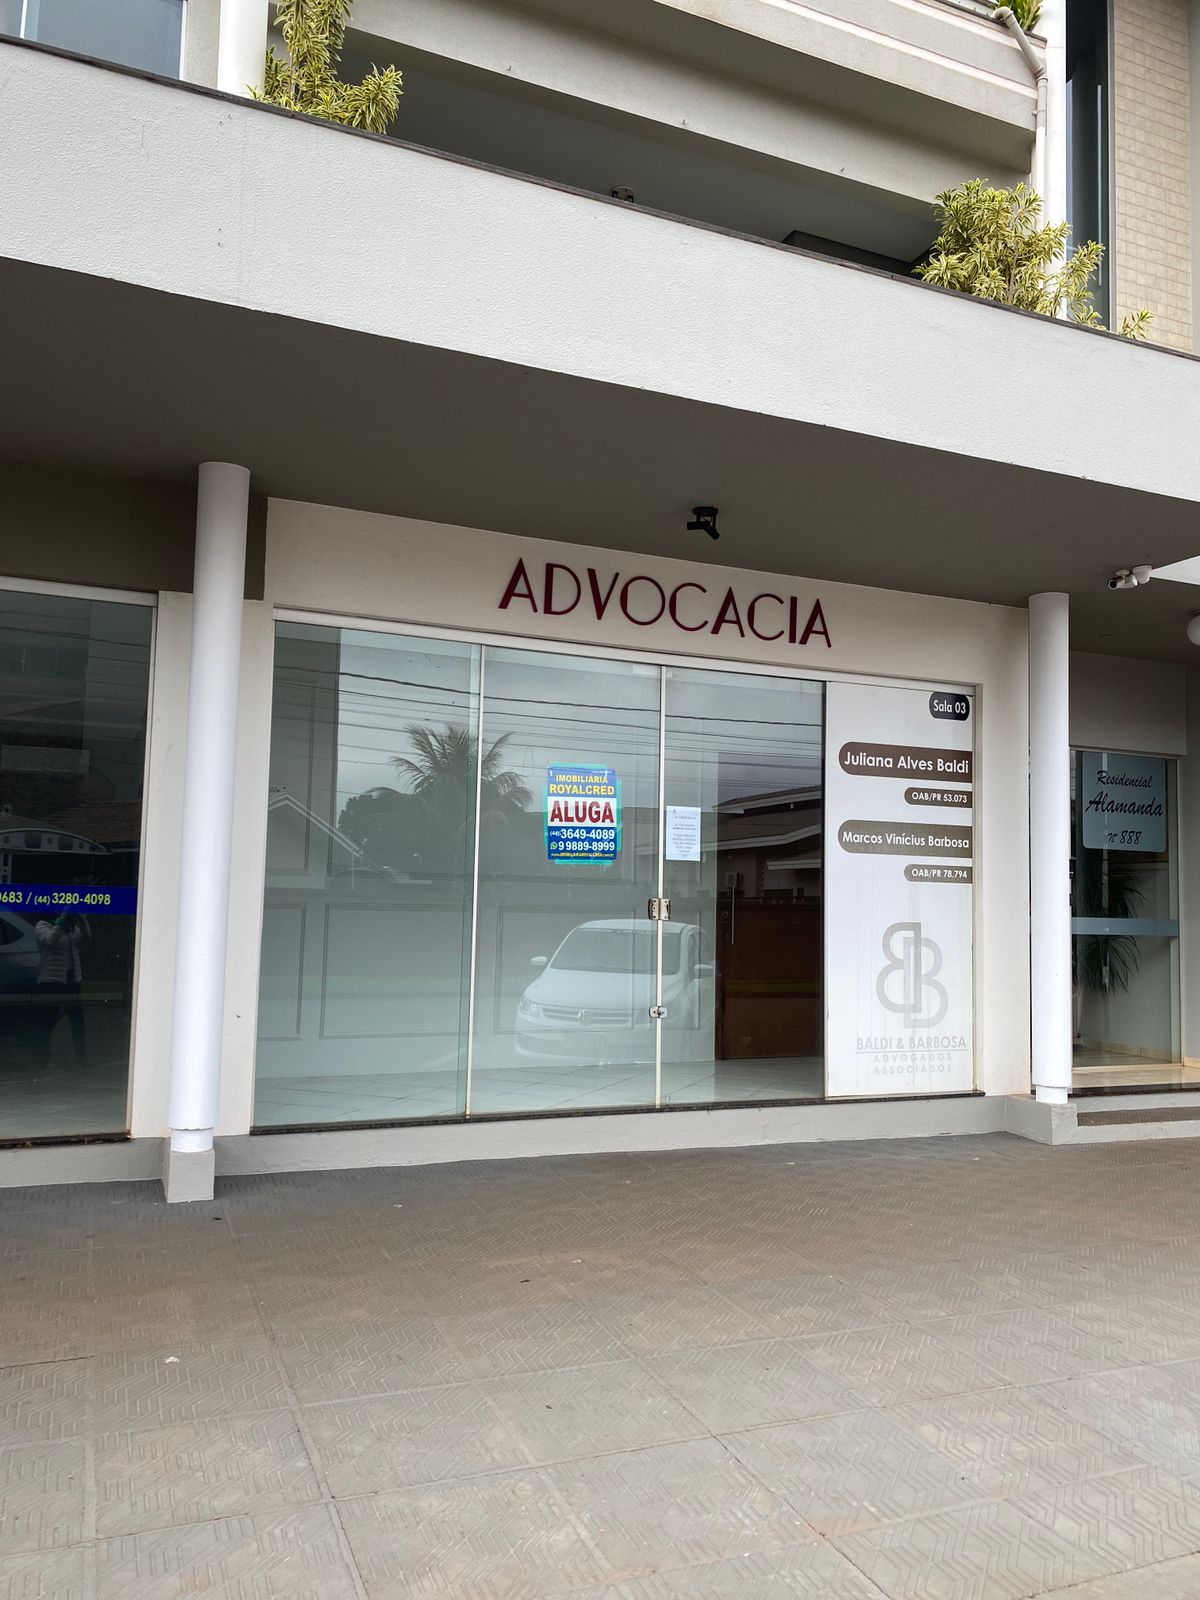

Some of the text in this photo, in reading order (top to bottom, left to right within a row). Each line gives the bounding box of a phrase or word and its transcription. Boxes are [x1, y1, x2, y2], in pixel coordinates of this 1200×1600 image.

[498, 557, 832, 648] ADVOCACIA
[933, 699, 966, 714] Sala 03
[844, 751, 969, 774] Juliana Alves Baldi
[1097, 770, 1152, 788] Residencial
[549, 784, 615, 795] ROYALCRED
[911, 791, 968, 804] OAB/PR 53.073
[1085, 790, 1164, 817] Alamanda
[550, 800, 615, 824] ALUGA
[842, 831, 970, 849] Marcos Vinícius Barbosa
[1120, 830, 1142, 845] 888
[558, 841, 615, 851] 9 9889-8999
[911, 868, 968, 879] OAB/PR 78.794
[0, 892, 23, 903] 683
[34, 895, 51, 906] (44)
[52, 892, 111, 905] 3280-4098
[856, 1035, 967, 1050] BALDI & BARBOSA
[873, 1053, 952, 1063] ADVOGADOS
[873, 1063, 953, 1075] ASSOCIADOS
